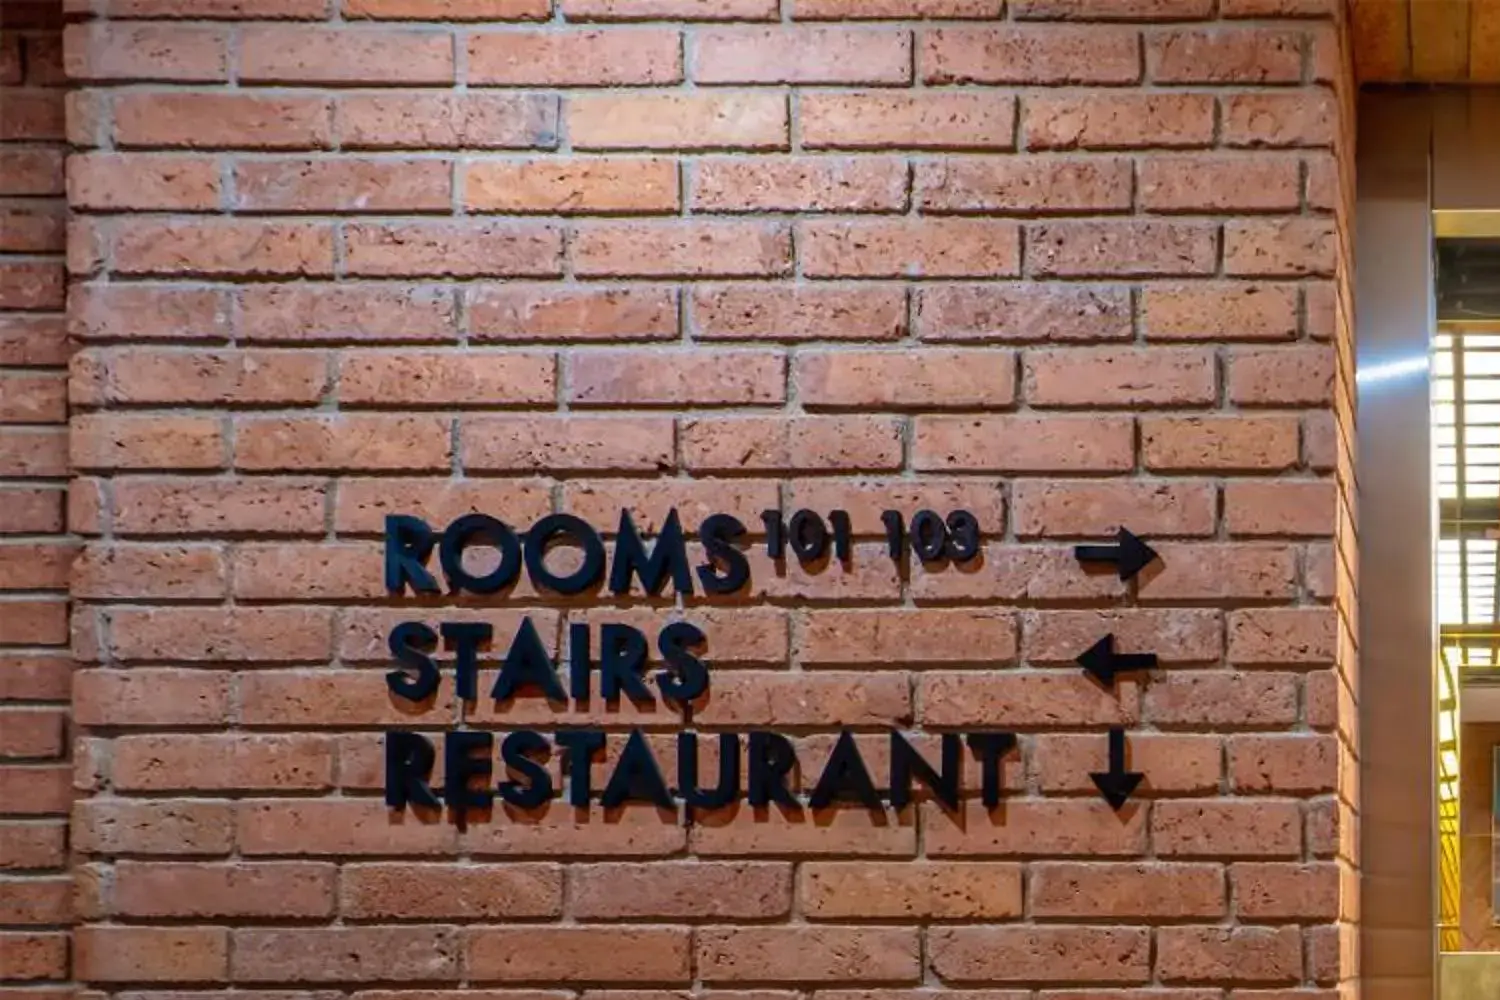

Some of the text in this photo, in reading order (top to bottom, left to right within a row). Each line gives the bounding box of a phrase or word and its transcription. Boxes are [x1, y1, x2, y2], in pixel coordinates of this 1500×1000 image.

[384, 507, 980, 595] ROOMS 101 103
[386, 616, 710, 702] STAIRS
[384, 728, 1017, 812] RESTAURANT
